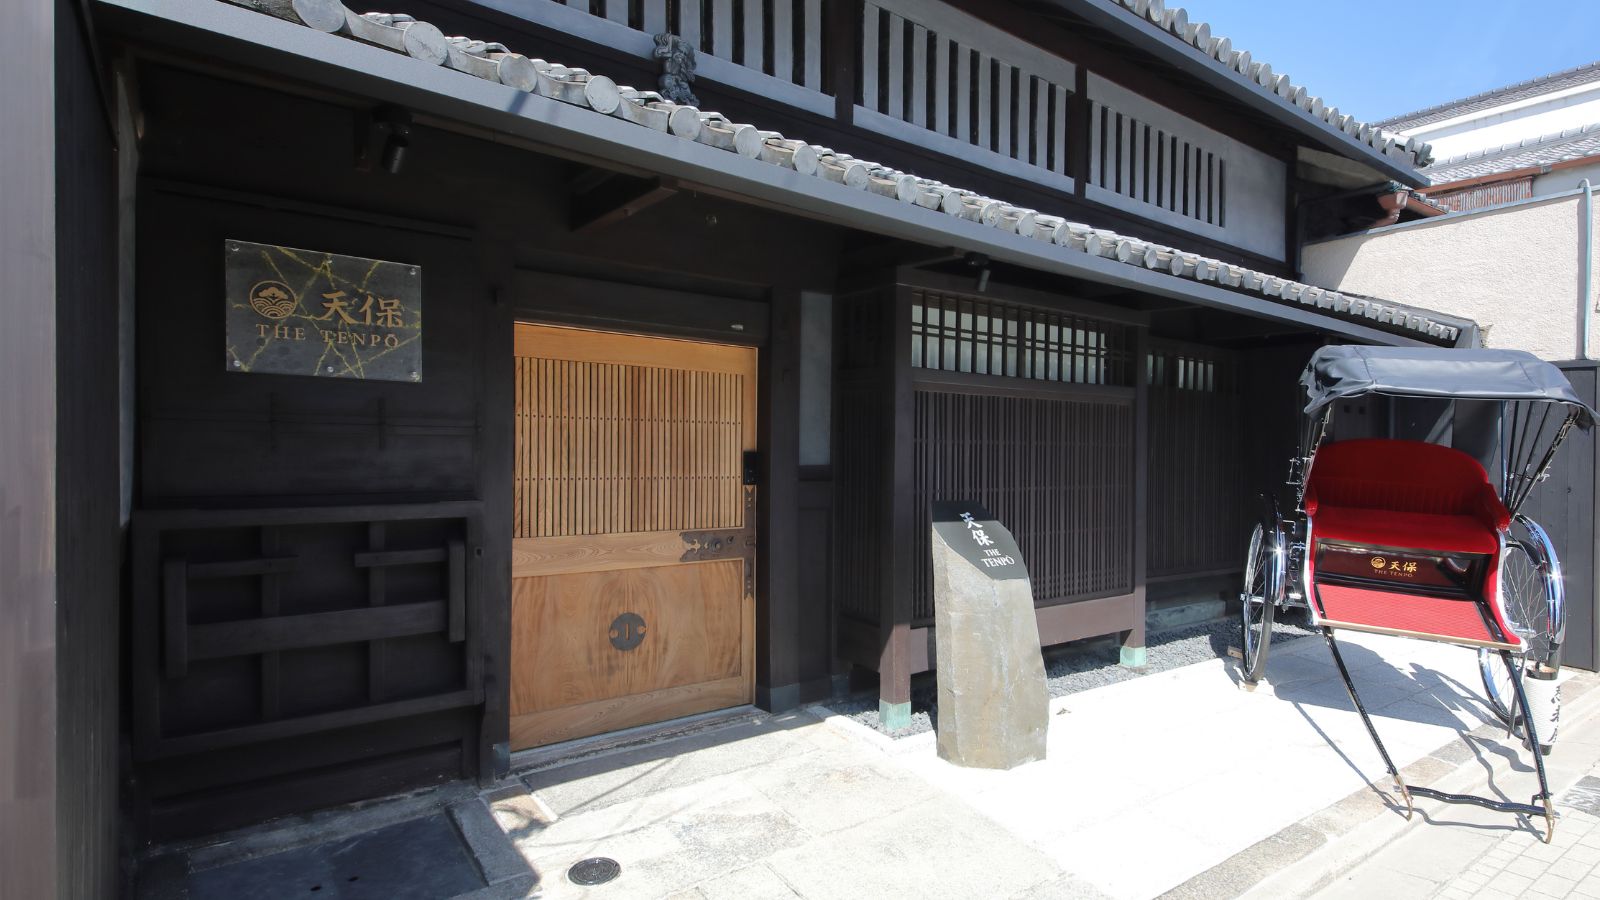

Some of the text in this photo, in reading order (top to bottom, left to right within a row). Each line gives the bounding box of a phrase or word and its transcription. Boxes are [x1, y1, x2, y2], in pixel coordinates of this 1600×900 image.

[320, 290, 403, 328] 天保
[255, 324, 306, 341] THE
[960, 512, 994, 546] 天保
[984, 548, 1001, 557] THE
[1389, 561, 1417, 573] 天保
